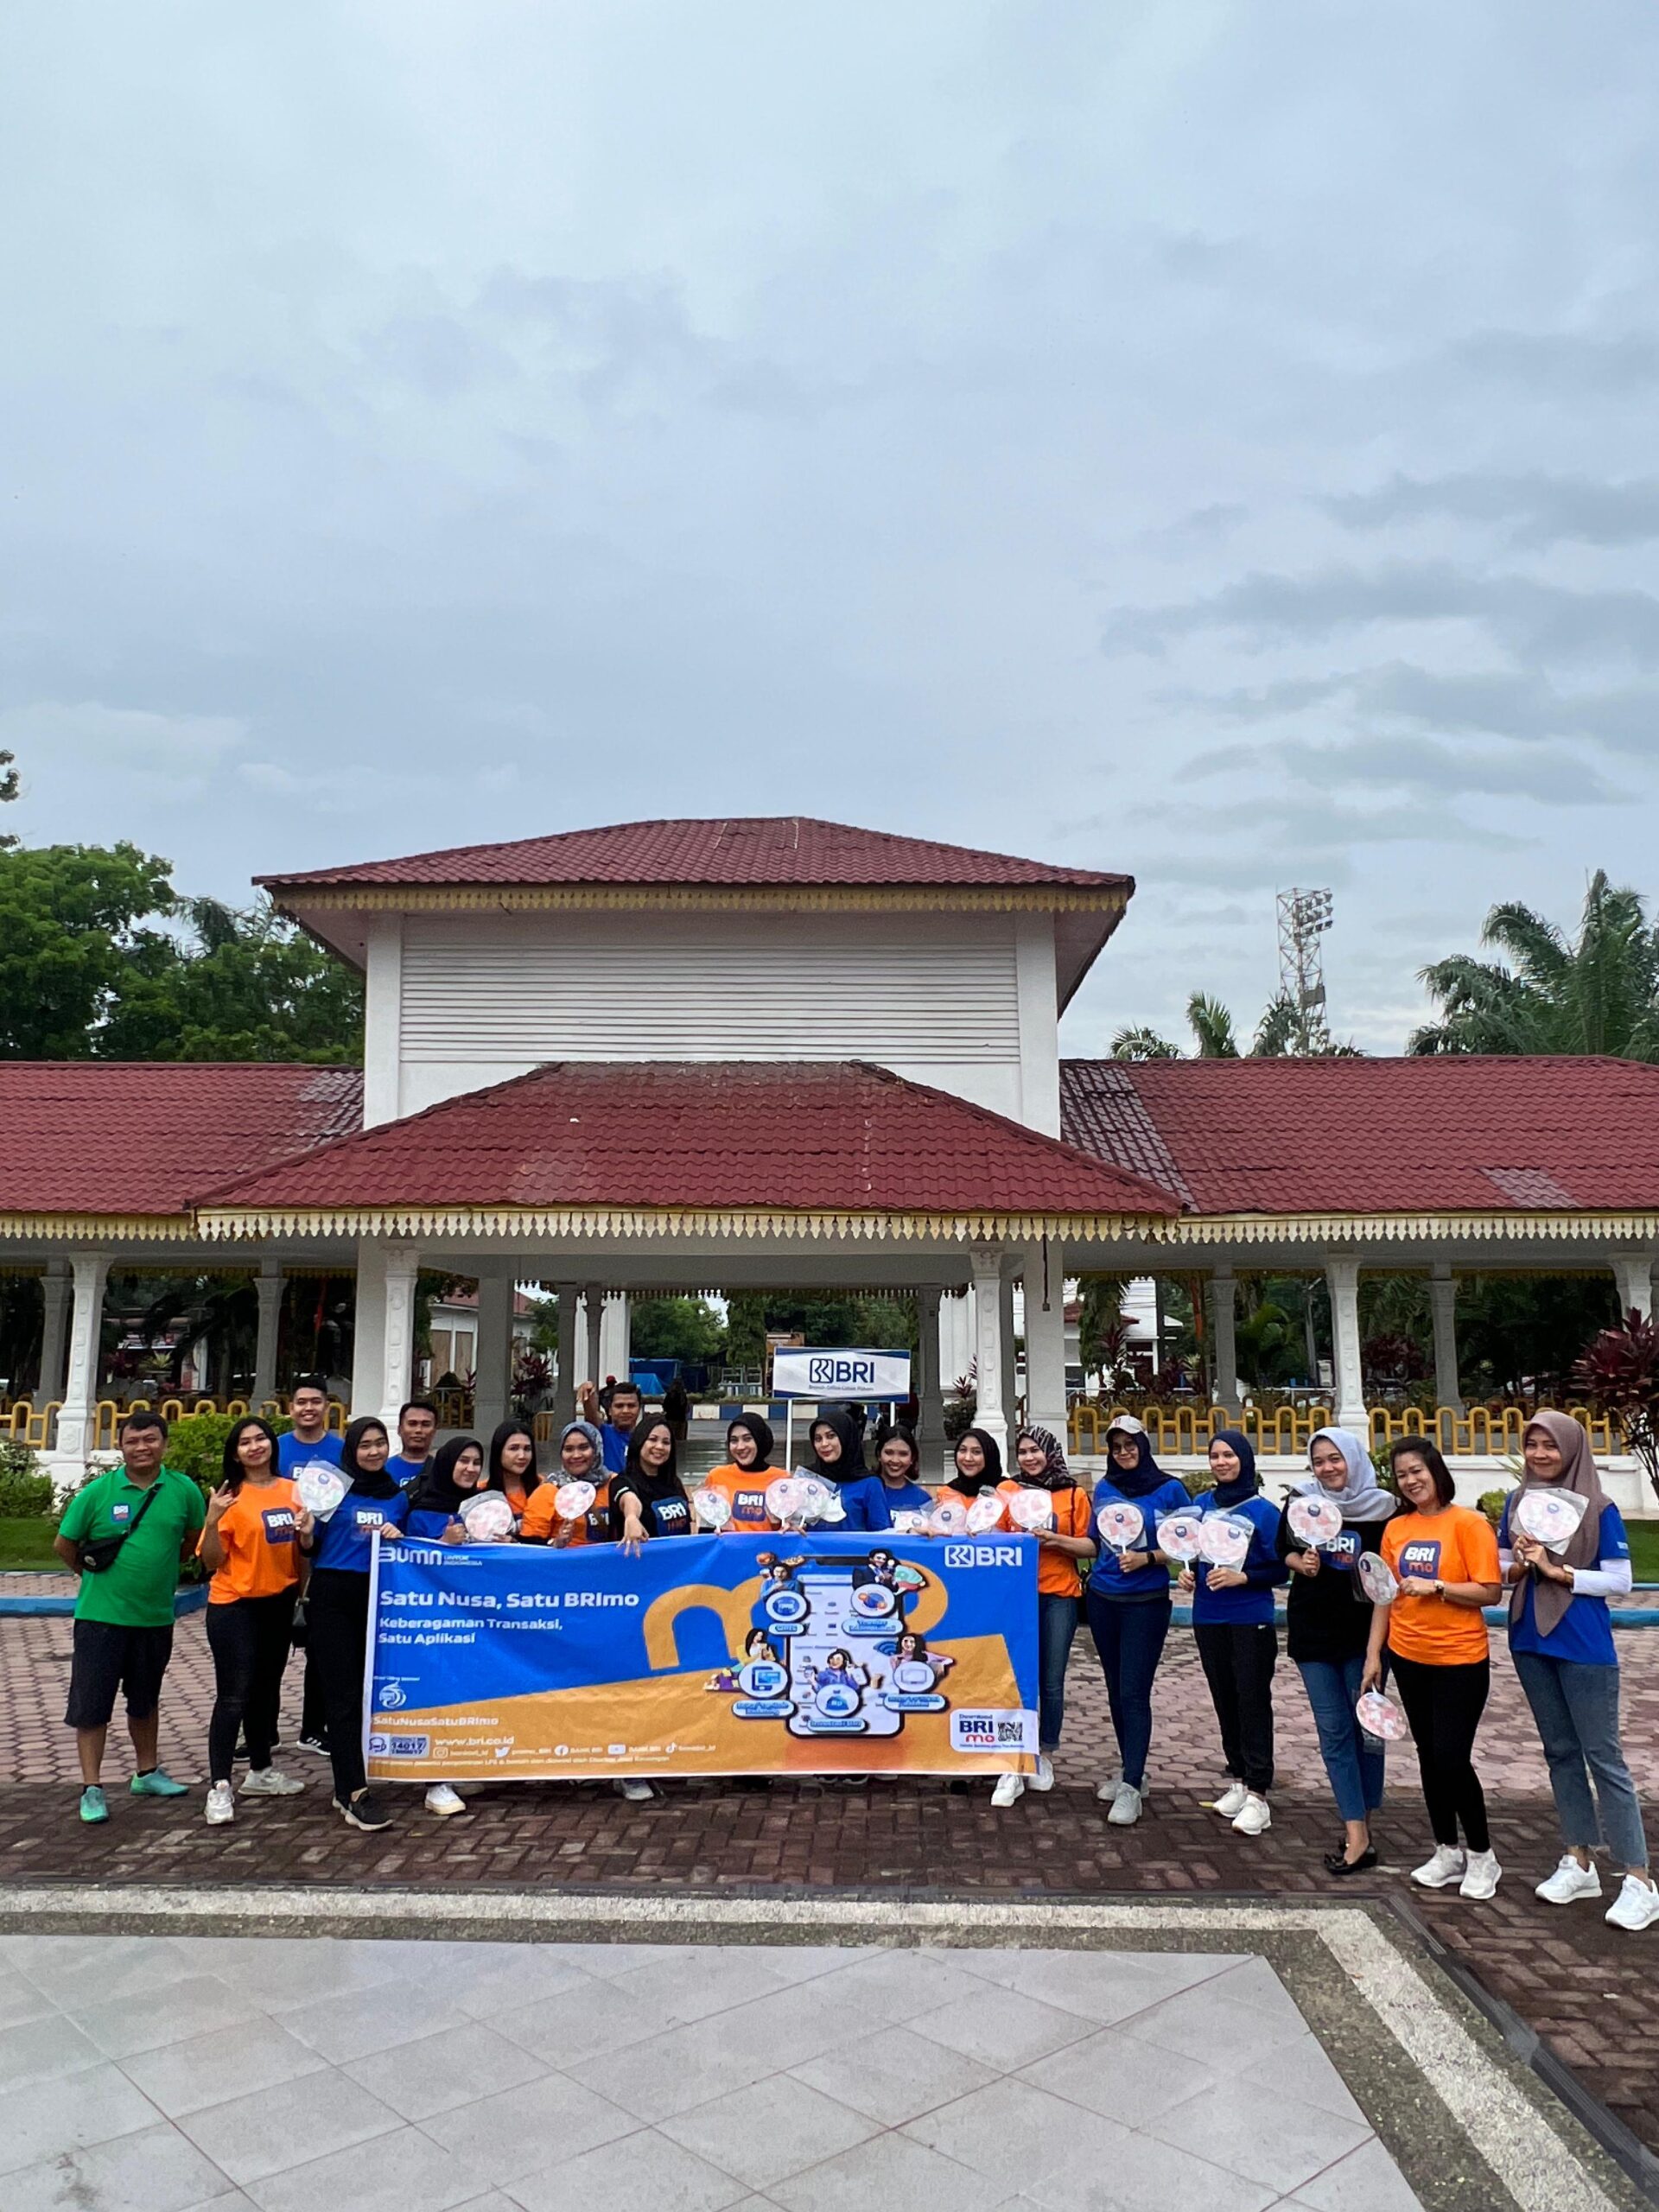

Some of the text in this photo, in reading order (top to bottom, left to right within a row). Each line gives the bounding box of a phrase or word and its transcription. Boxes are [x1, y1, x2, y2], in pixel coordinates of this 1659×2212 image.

[836, 1361, 874, 1382] BRI
[738, 1493, 763, 1505] BRI
[113, 1504, 129, 1515] BRI
[658, 1503, 687, 1521] BRI
[266, 1513, 294, 1528] BRI
[357, 1511, 384, 1525] BRI
[588, 1512, 609, 1526] BI
[1326, 1537, 1355, 1554] BRI
[976, 1547, 1022, 1567] BRI
[1405, 1547, 1436, 1561] BRI
[1408, 1561, 1433, 1573] mo
[380, 1591, 640, 1610] Satu Nusa, Satu BRImo
[379, 1618, 563, 1630] Keberagaman Transaksi,
[378, 1632, 476, 1645] Satu Aplikasi
[959, 1720, 994, 1733] BRI
[435, 1736, 515, 1745] www.bri.co.id
[965, 1734, 995, 1743] mo
